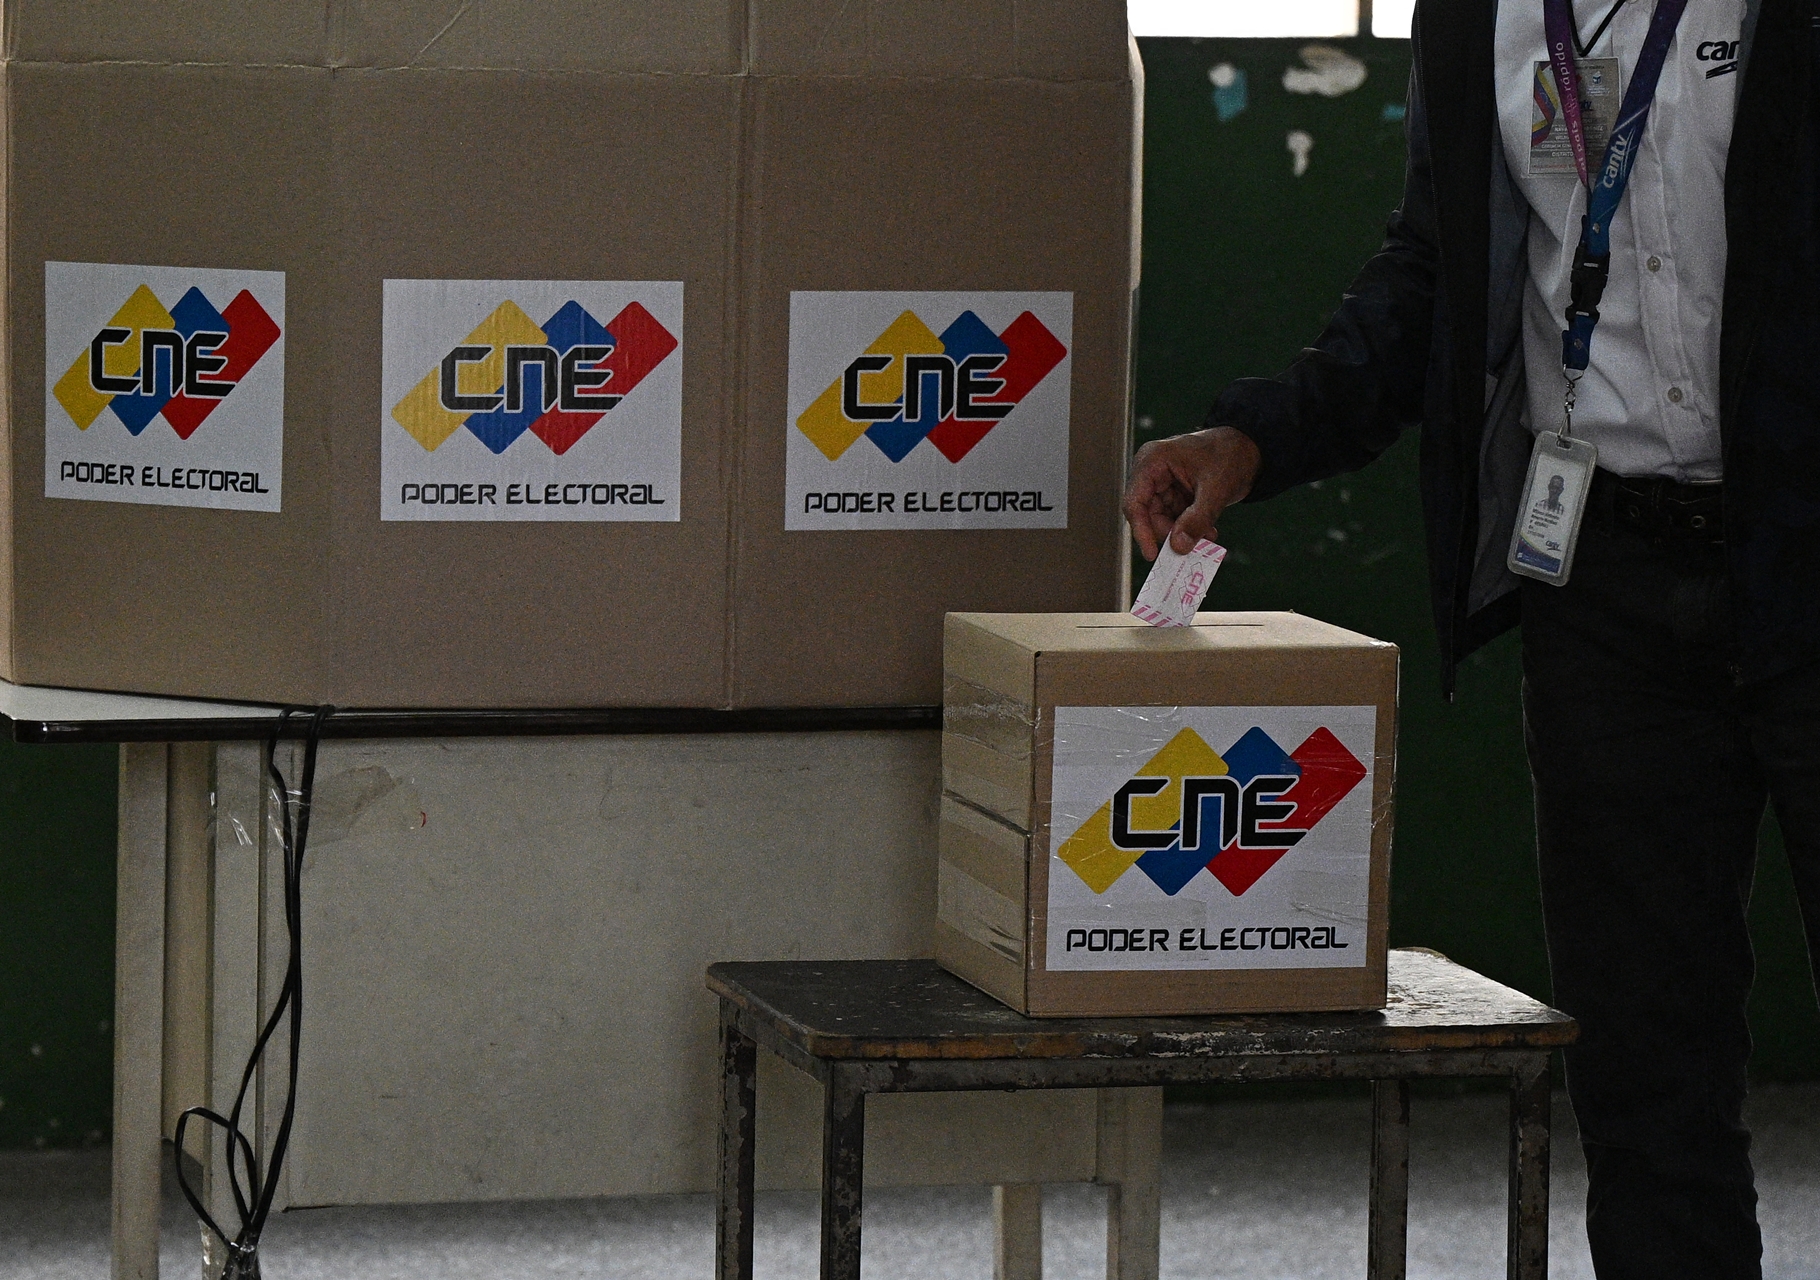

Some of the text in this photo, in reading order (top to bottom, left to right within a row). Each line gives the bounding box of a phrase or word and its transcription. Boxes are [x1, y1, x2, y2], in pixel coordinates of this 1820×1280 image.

[1555, 42, 1571, 91] rápido
[1571, 120, 1584, 152] país
[61, 460, 269, 495] PODER ELECTORAL
[401, 483, 666, 505] PODER ELECTORAL
[804, 489, 1057, 514] PODER ELECTORAL
[1066, 926, 1348, 952] PODER ELECTORAL
